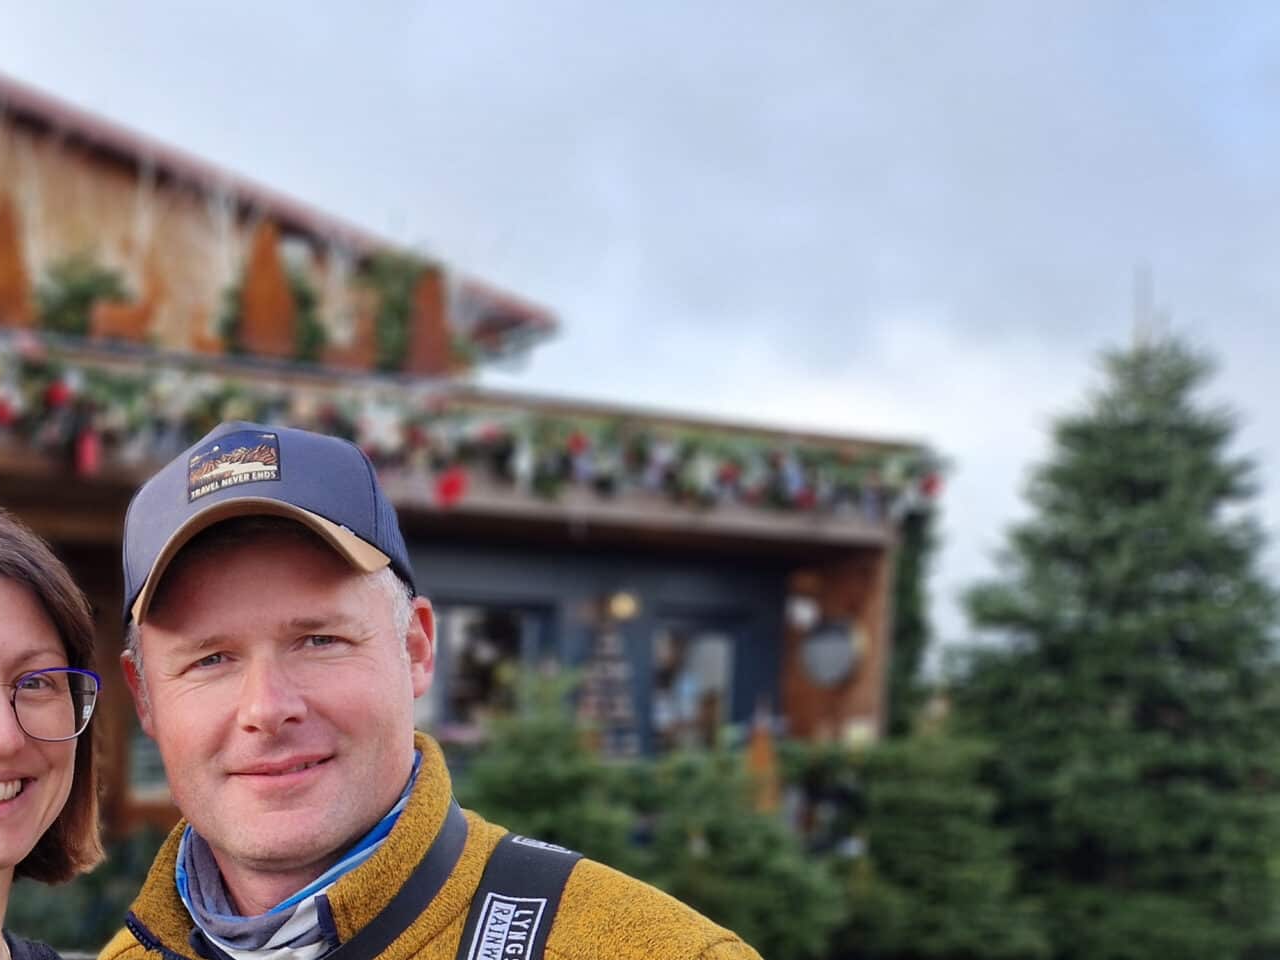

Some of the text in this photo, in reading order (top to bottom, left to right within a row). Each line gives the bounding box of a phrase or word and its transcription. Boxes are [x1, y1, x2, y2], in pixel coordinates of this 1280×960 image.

[191, 471, 276, 498] TRAVEL NEVER ENDS
